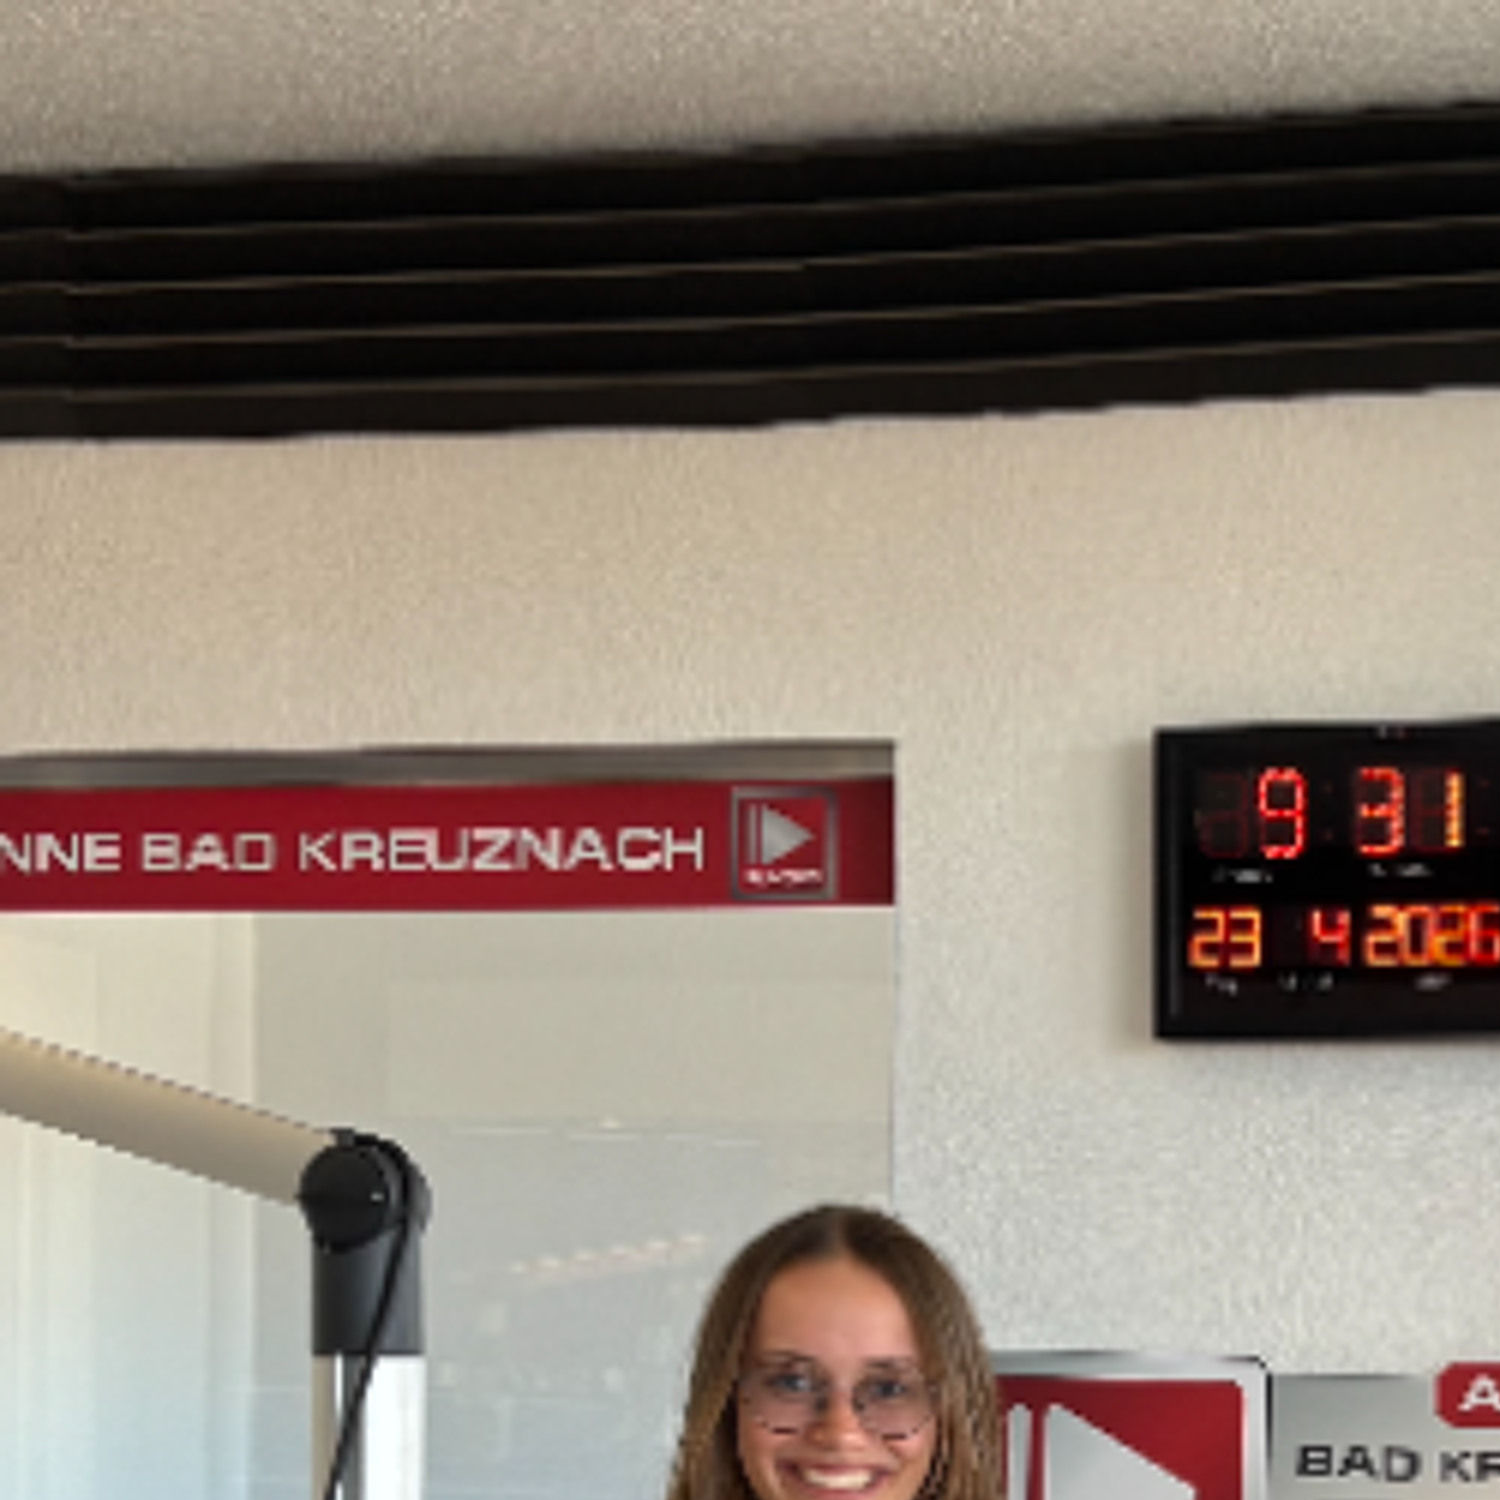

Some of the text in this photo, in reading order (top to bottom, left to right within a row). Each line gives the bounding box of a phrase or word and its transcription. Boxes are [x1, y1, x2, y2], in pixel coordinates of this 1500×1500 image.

[1258, 765, 1308, 860] 9
[1357, 765, 1466, 856] 31
[141, 833, 277, 873] BAD
[299, 827, 704, 872] KREUZNACH
[1189, 905, 1262, 968] 23
[1310, 908, 1351, 968] 4
[1295, 1444, 1421, 1482] BAD
